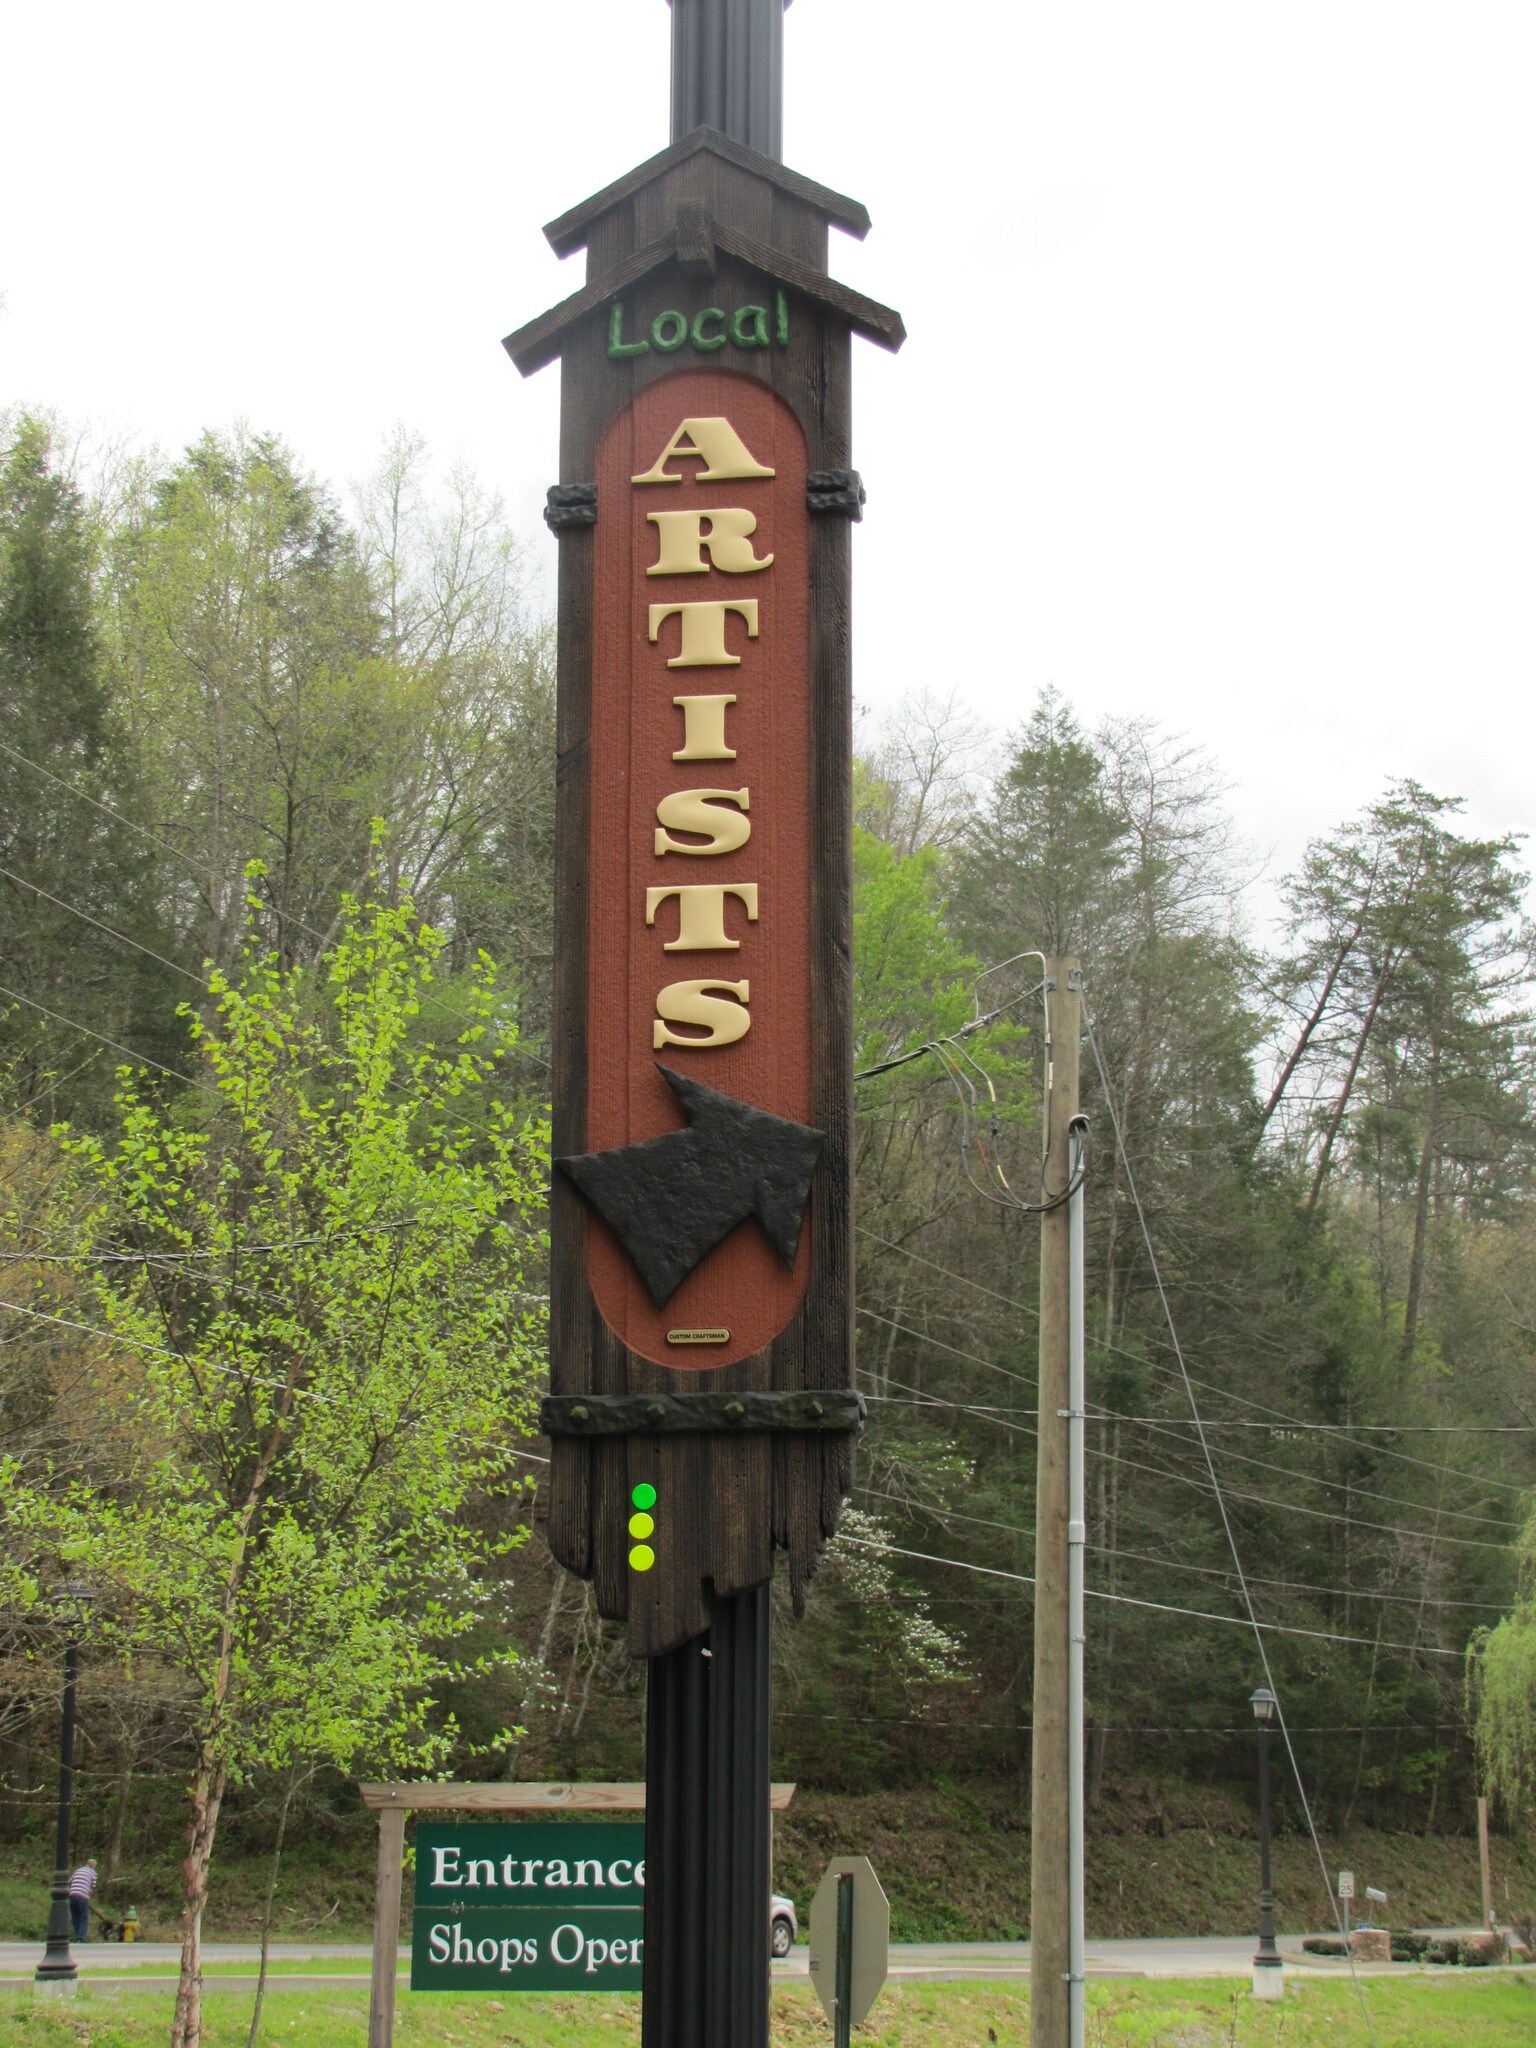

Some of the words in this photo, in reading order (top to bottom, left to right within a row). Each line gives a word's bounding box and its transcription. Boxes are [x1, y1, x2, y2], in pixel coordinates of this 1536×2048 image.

[608, 288, 789, 358] Local
[631, 417, 776, 1049] ARTISTS
[1340, 1885, 1352, 1895] 25
[429, 1922, 538, 1973] Shops
